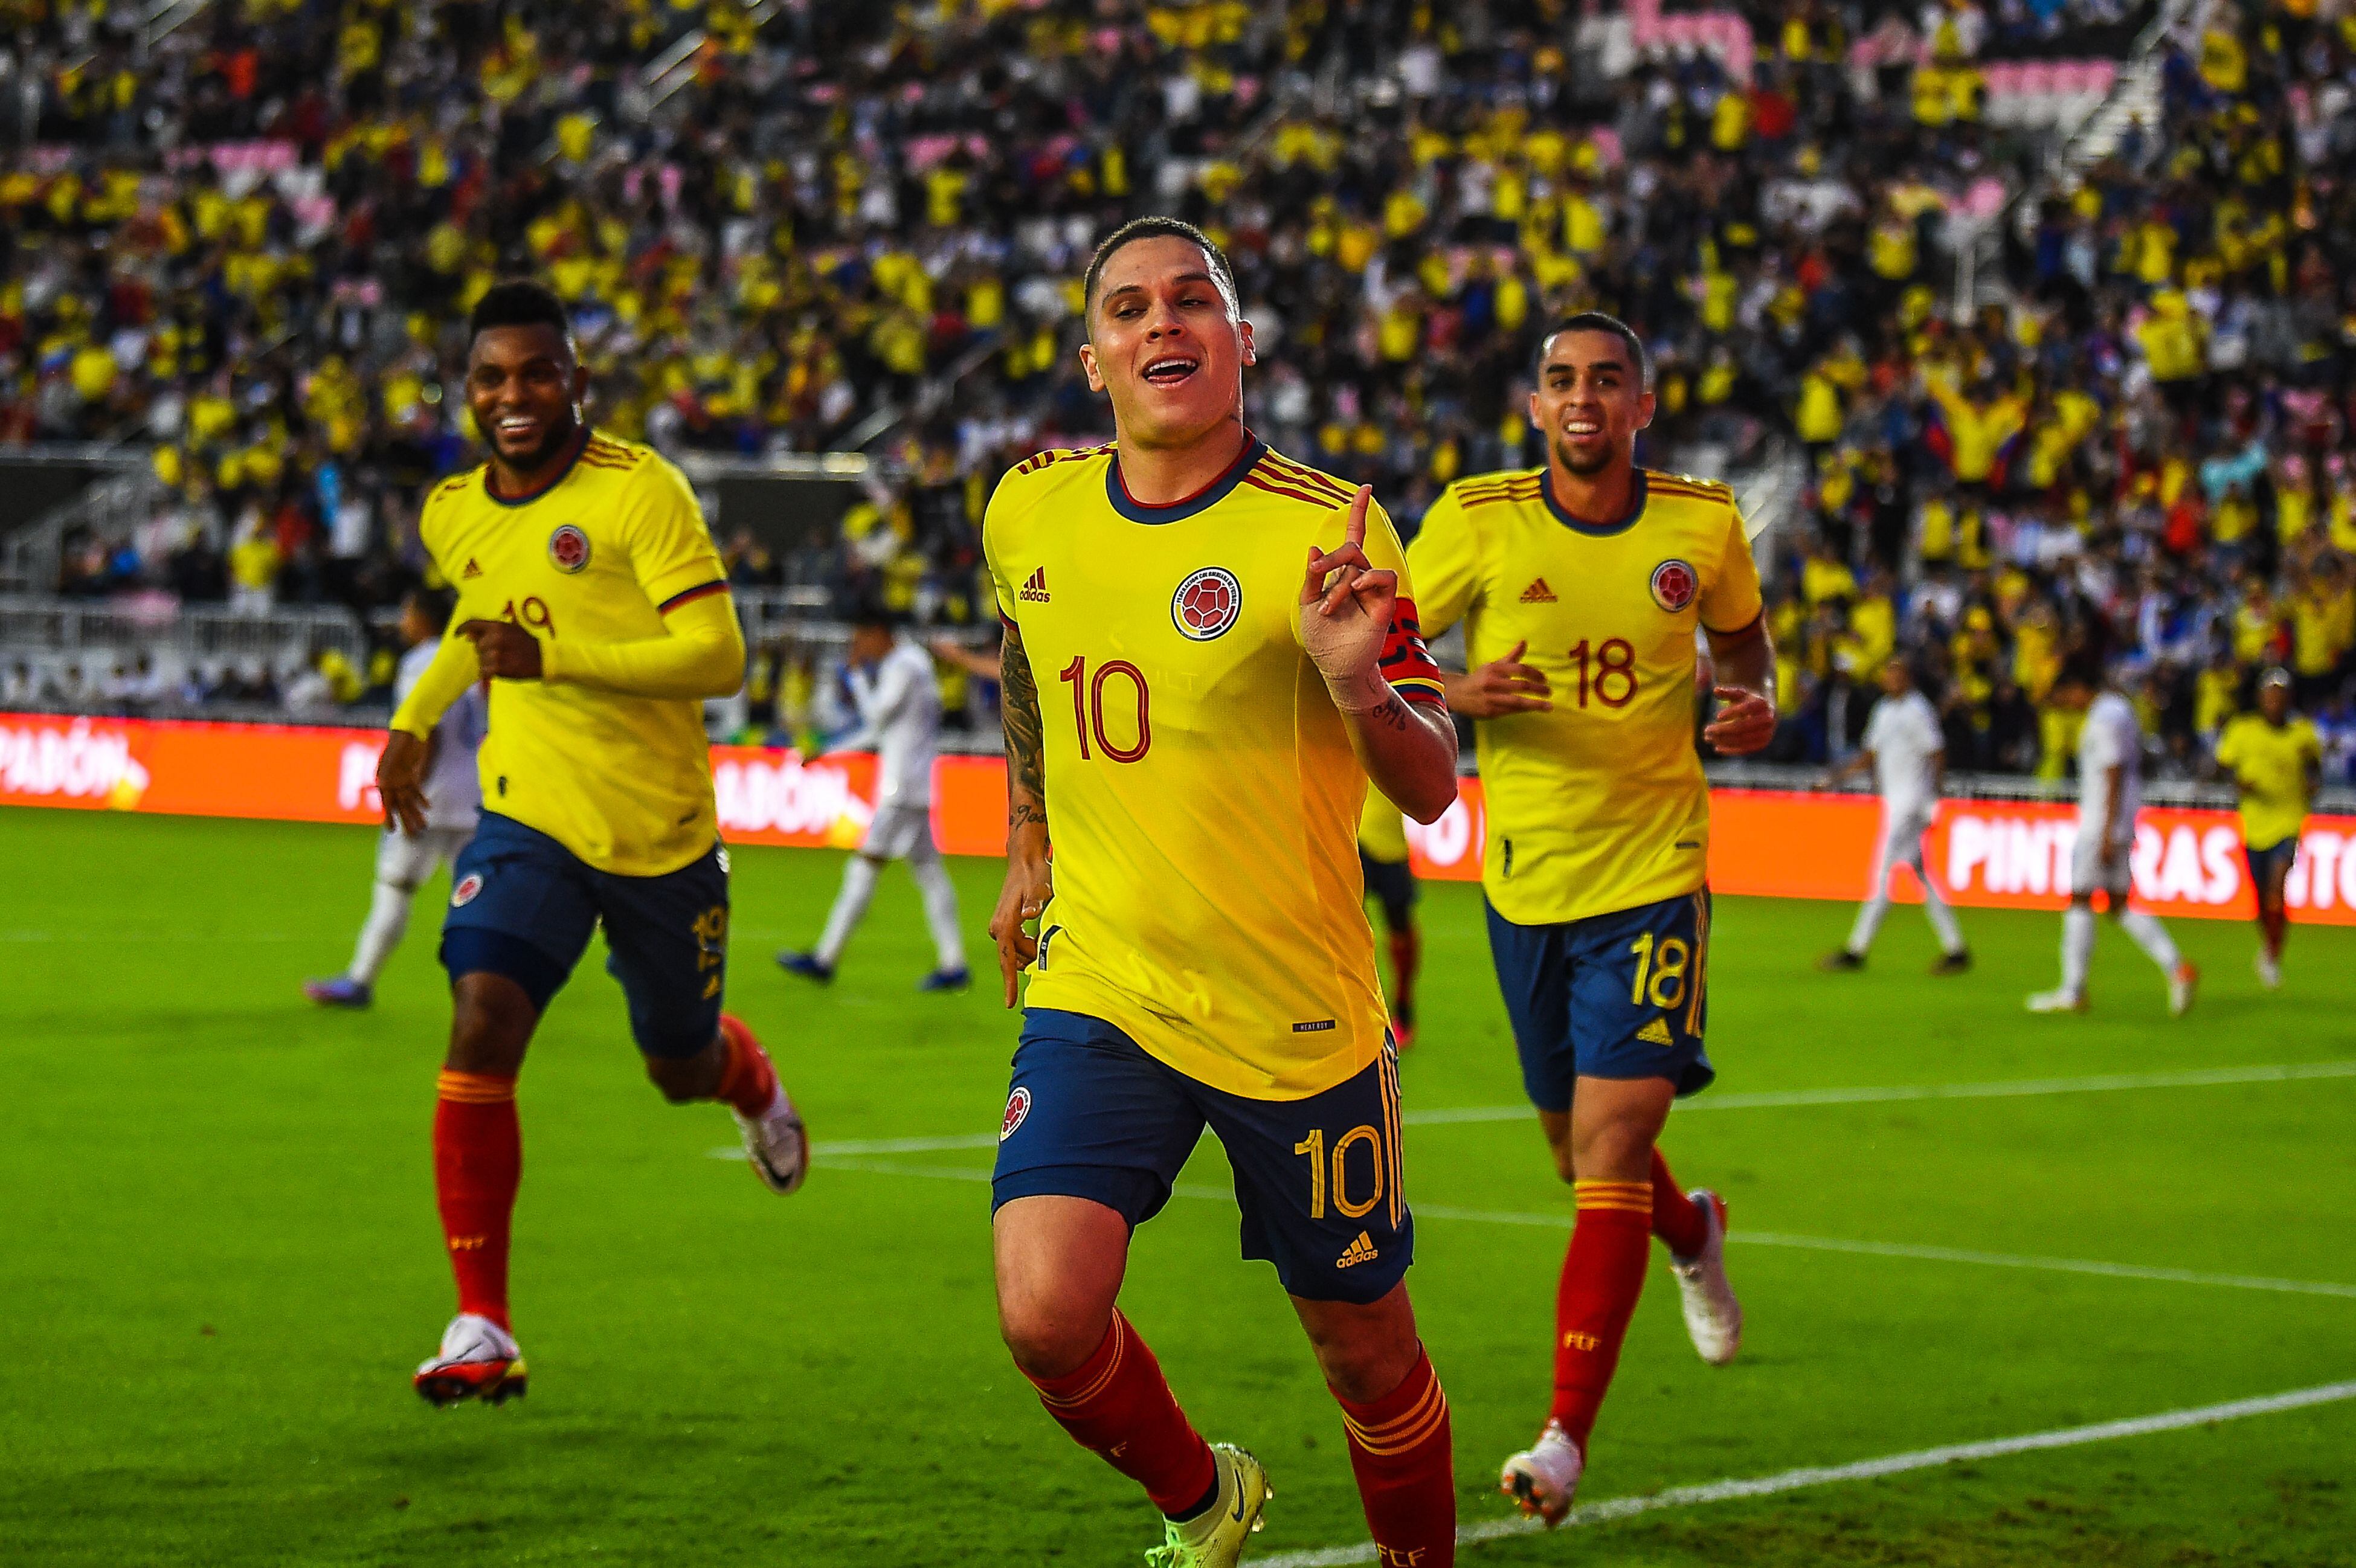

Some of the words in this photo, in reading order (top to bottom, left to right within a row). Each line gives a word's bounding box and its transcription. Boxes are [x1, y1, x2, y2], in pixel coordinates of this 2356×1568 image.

[1019, 586, 1051, 603] adidas
[1060, 655, 1151, 764] 10
[1569, 638, 1639, 709] 18
[1947, 815, 2240, 906] PINTRAS
[1631, 930, 1690, 1011] 18
[1294, 1124, 1384, 1219] 10
[1336, 1249, 1379, 1268] adidas
[1377, 1543, 1426, 1568] FCF
